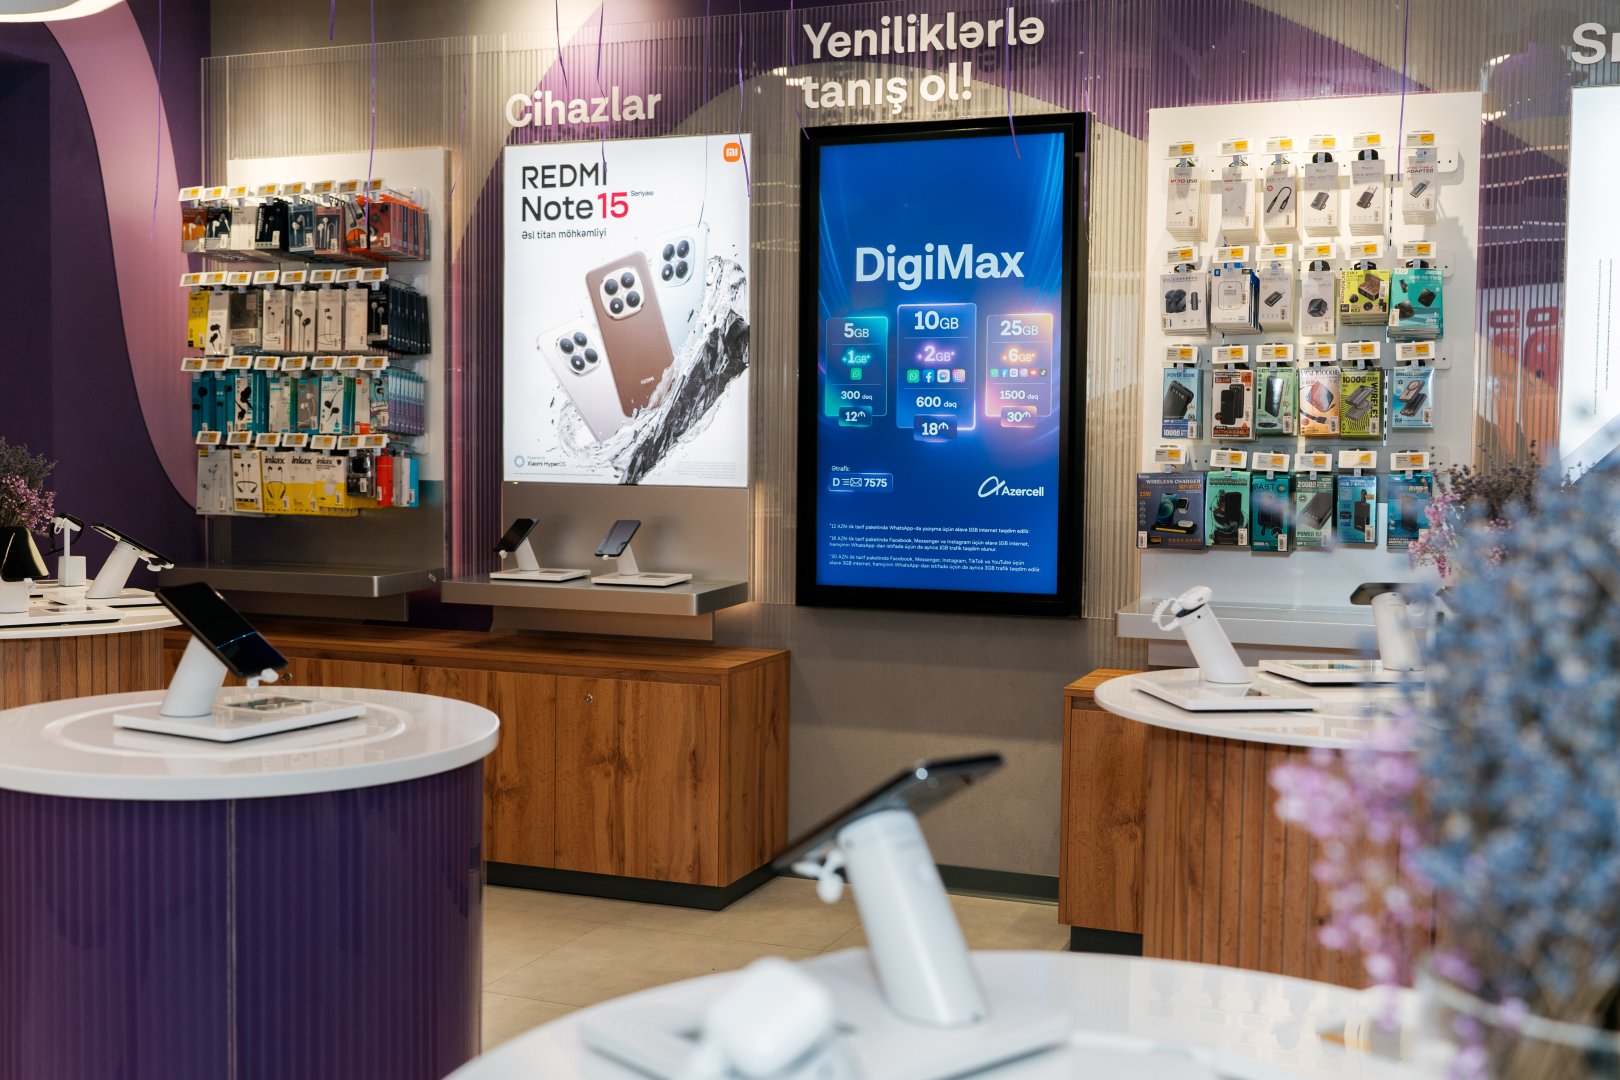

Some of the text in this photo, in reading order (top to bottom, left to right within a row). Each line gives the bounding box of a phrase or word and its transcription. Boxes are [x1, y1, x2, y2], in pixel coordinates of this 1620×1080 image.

[803, 7, 1044, 59] Yeniliklərlə
[802, 62, 972, 114] tanış ol!
[506, 86, 662, 128] Cihazlar
[522, 162, 607, 189] REDMI
[522, 192, 628, 222] Note 15
[537, 230, 556, 239] titan
[558, 228, 606, 238] möhkəmliyi
[856, 243, 1024, 290] DigiMax
[914, 310, 958, 330] 10GB
[1000, 320, 1038, 336] 25GB
[844, 322, 870, 338] 5GB
[841, 391, 860, 400] 300
[916, 396, 941, 408] 600
[1000, 390, 1025, 400] 1500
[265, 456, 285, 464] inkax
[292, 456, 312, 464] inkax
[832, 478, 887, 488] D 7575
[1001, 486, 1044, 496] Azercell
